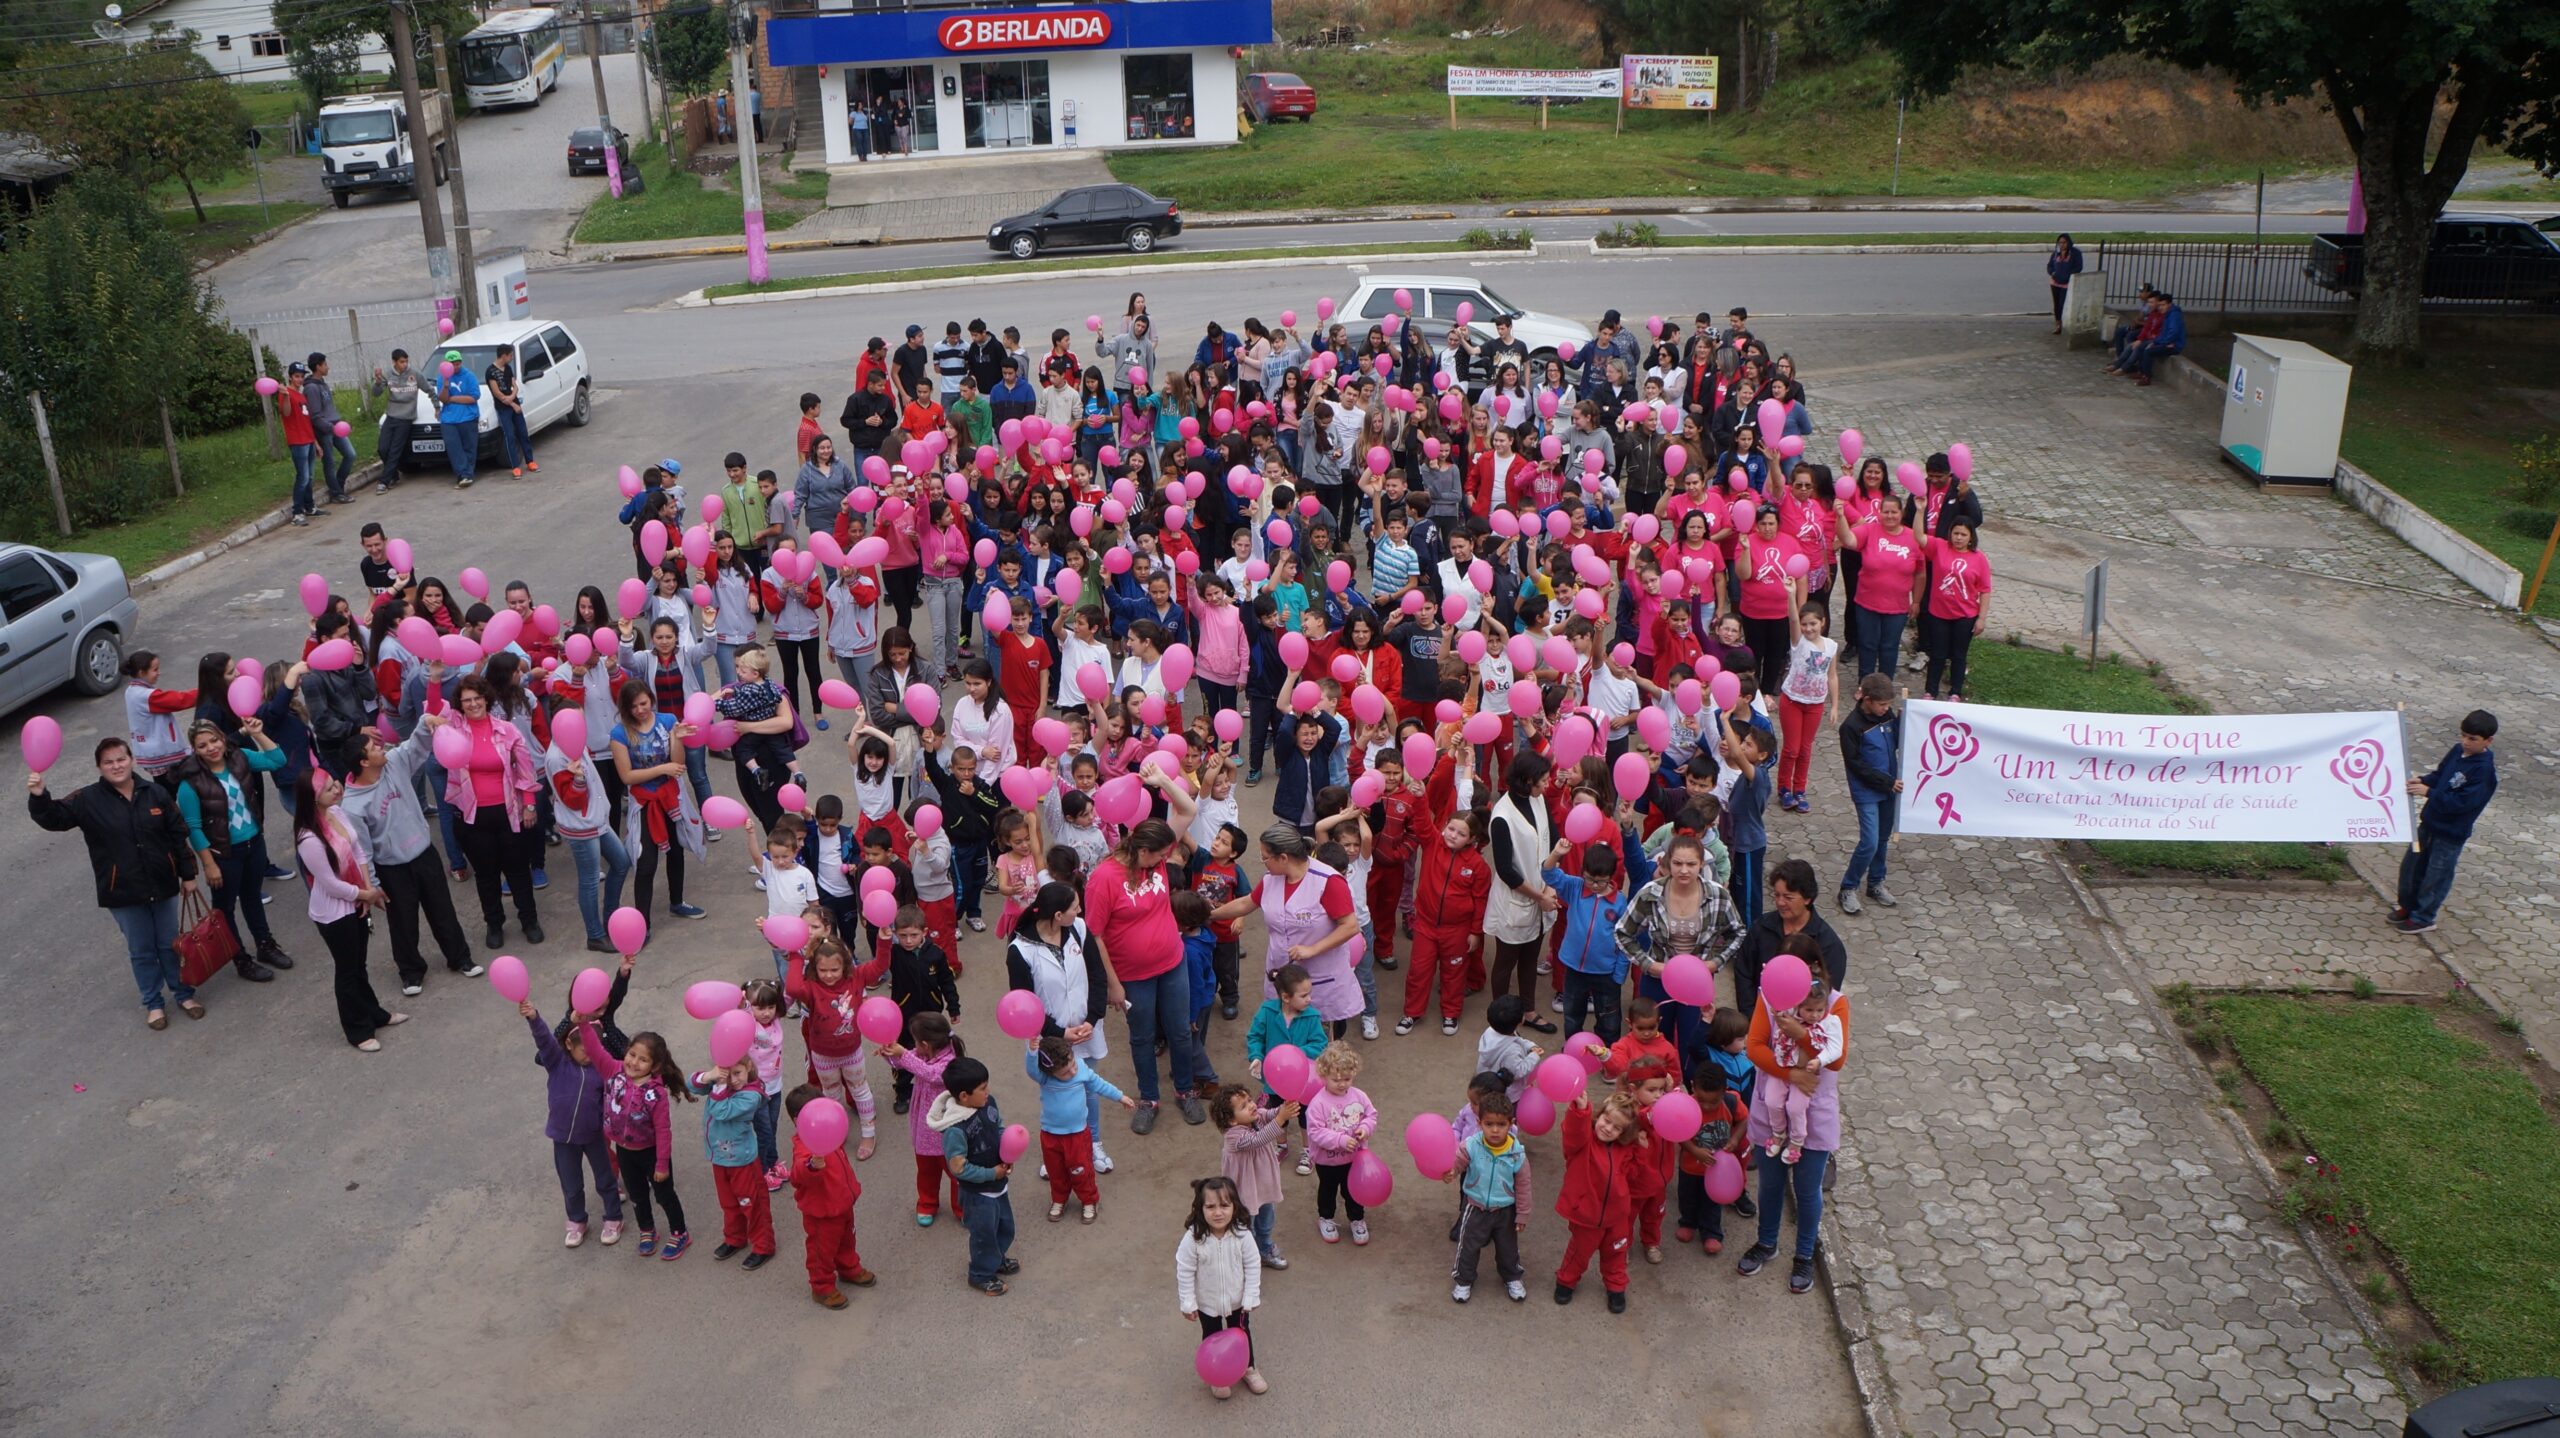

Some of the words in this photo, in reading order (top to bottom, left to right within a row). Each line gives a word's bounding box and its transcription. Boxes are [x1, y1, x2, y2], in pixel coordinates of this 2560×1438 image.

[977, 17, 1104, 43] BERLANDA
[1450, 69, 1473, 77] FESTA
[1475, 69, 1487, 77] EM
[1489, 69, 1519, 78] HONRA
[2062, 723, 2127, 748] Um
[2138, 723, 2242, 755] Toque
[1993, 753, 2058, 780] Um
[2068, 756, 2136, 782] Ato
[2147, 755, 2187, 783] de
[2196, 759, 2303, 785] Amor
[2004, 788, 2102, 806] Secretaria
[2108, 791, 2207, 814] Municipal
[2213, 793, 2235, 810] de
[2240, 793, 2299, 810] Saúde
[2074, 812, 2152, 829] Bocaina
[2157, 813, 2182, 830] do
[2186, 814, 2221, 831] Sul
[2346, 817, 2387, 825] OUTUBRO
[2347, 826, 2390, 839] ROSA
